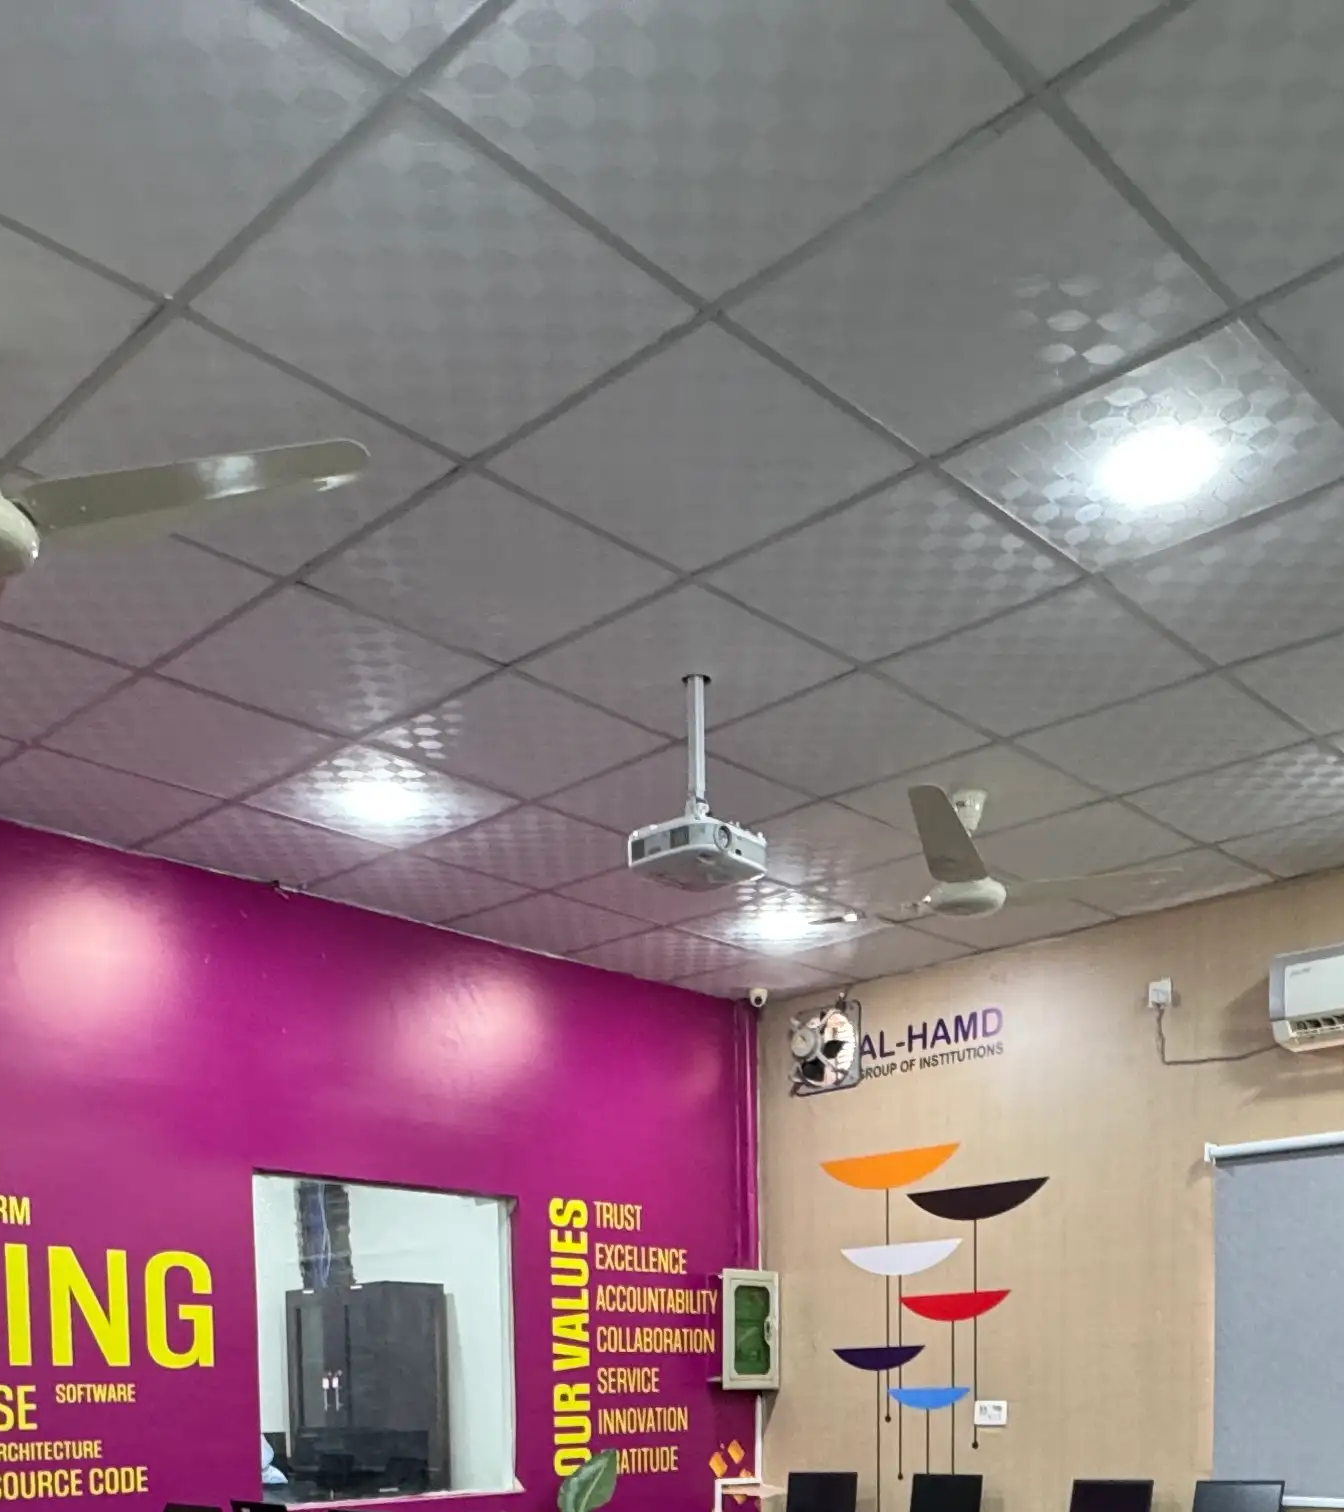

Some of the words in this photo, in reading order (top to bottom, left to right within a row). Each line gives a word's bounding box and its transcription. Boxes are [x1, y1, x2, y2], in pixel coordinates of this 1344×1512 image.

[860, 1007, 1004, 1060] AL-HAMD
[900, 1058, 916, 1073] OF
[919, 1041, 1004, 1070] INSTITUTIONS
[594, 1200, 642, 1230] TRUST
[595, 1243, 686, 1274] EXCELLENCE
[549, 1198, 590, 1371] VALUES
[596, 1285, 718, 1314] ACCOUNTABILITY
[597, 1326, 715, 1353] COLLABORATION
[56, 1384, 135, 1403] SOFTWARE
[597, 1367, 659, 1394] SERVICE
[553, 1384, 593, 1476] OUR
[598, 1407, 688, 1434] INNOVATION
[89, 1466, 147, 1495] CODE
